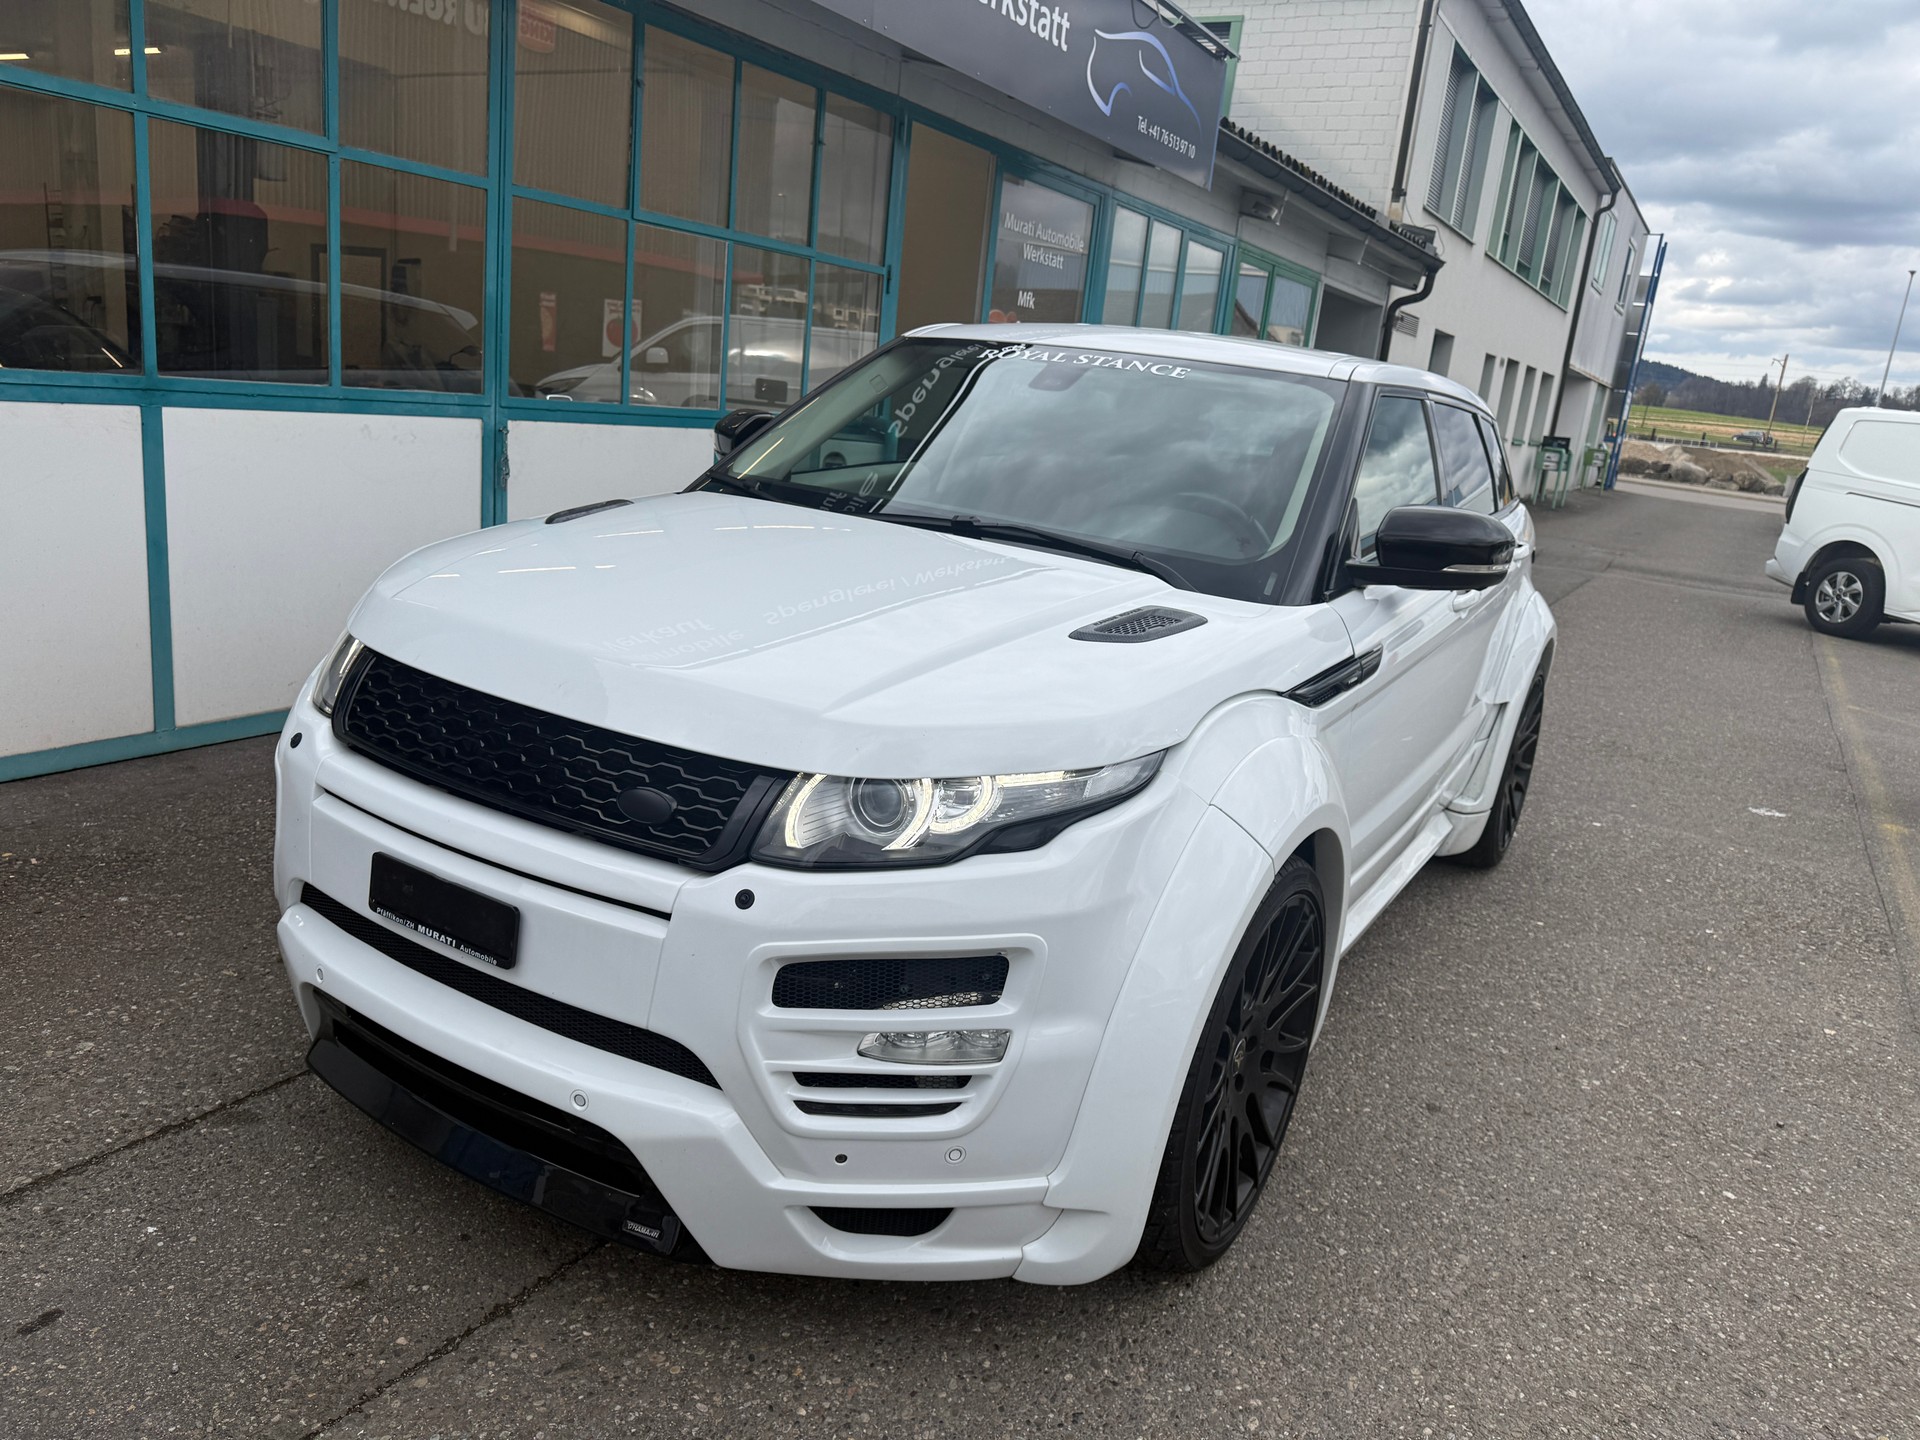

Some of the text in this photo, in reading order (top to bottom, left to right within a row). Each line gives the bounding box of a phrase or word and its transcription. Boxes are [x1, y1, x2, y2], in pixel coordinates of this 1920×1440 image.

[1004, 212, 1084, 252] Murati Automobile
[1023, 243, 1064, 270] Werkstatt
[1017, 290, 1035, 310] Mfk
[977, 347, 1191, 379] ROYAL STANCE
[417, 924, 456, 947] MURATI
[460, 944, 498, 966] Automobile
